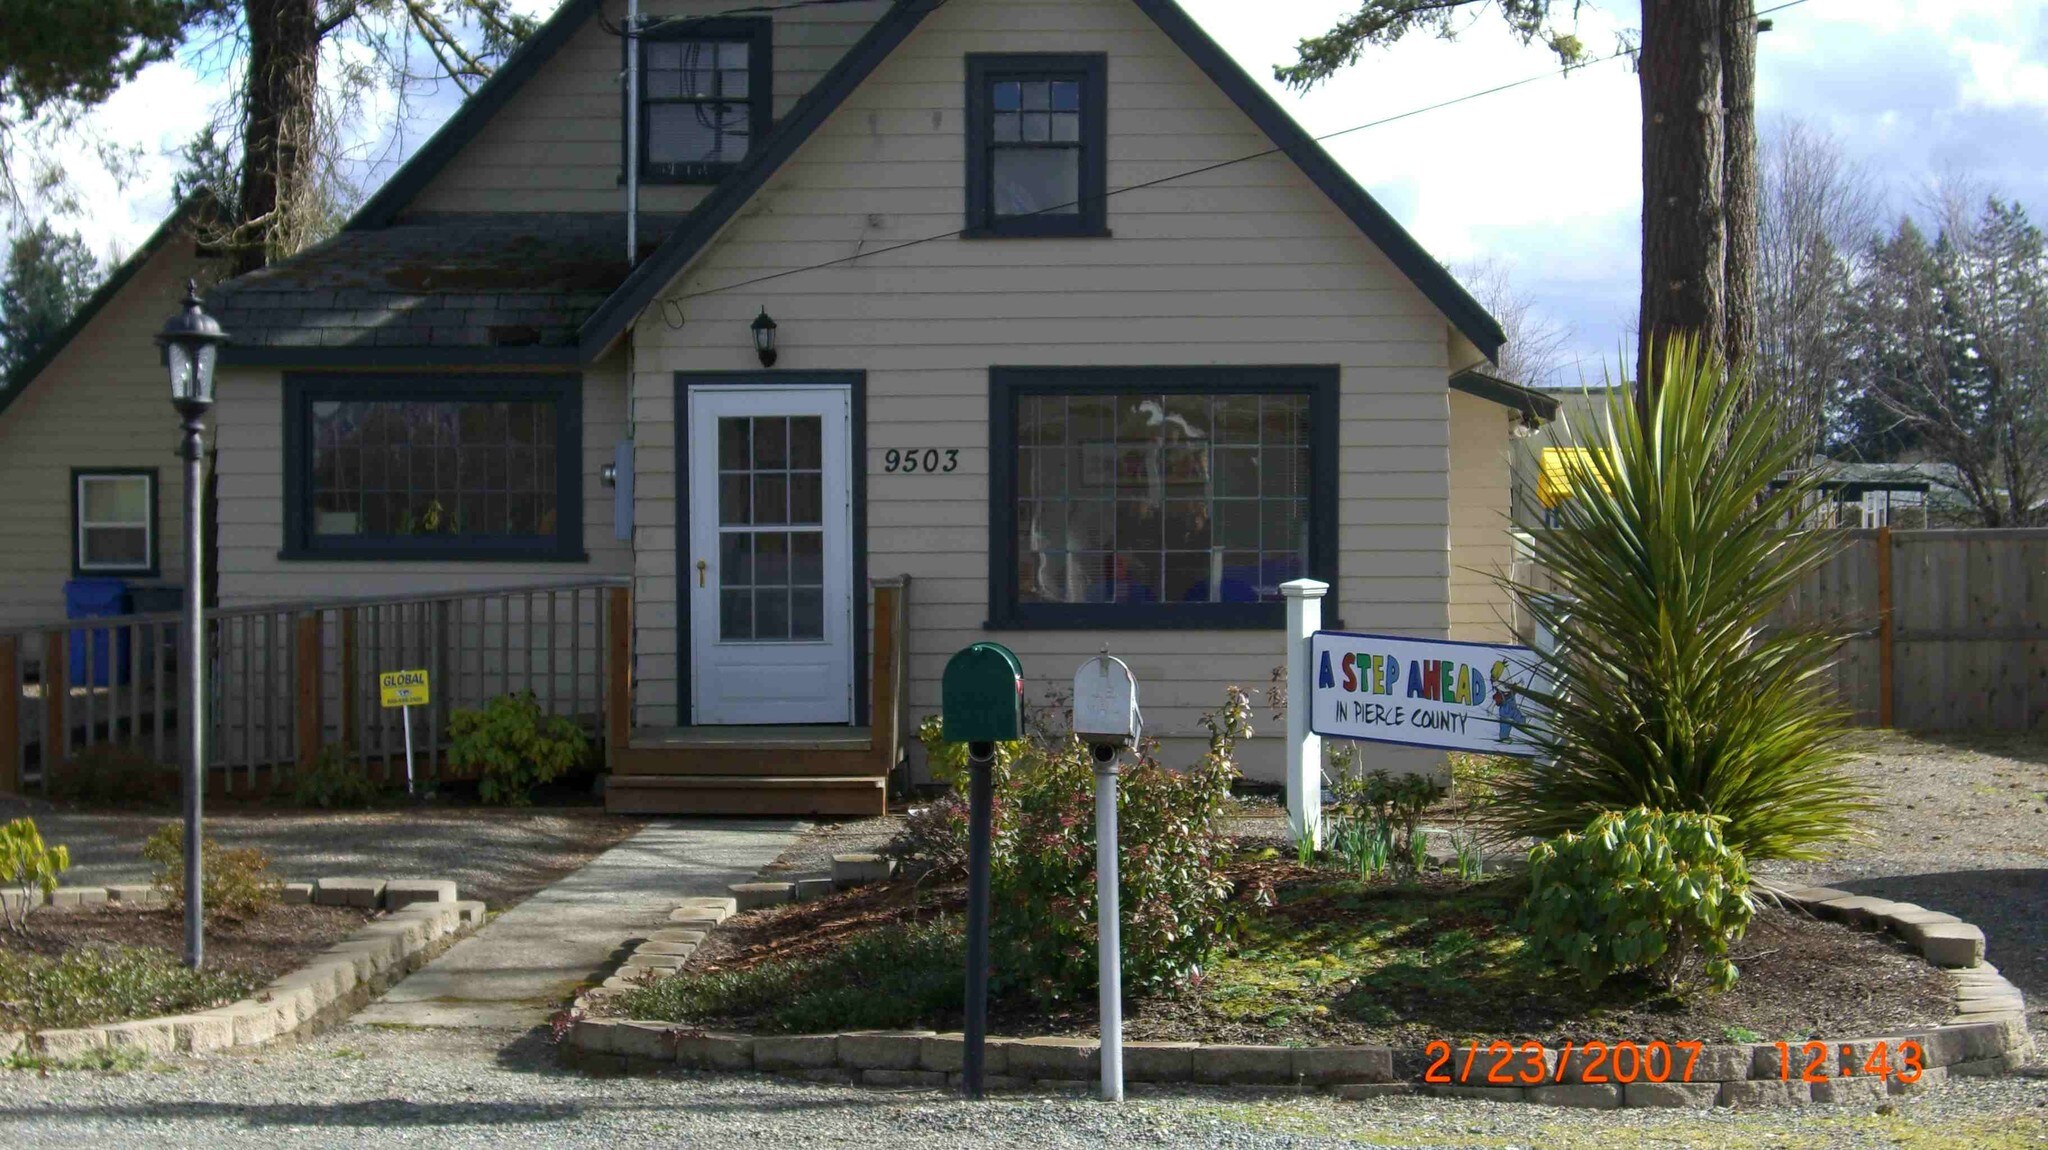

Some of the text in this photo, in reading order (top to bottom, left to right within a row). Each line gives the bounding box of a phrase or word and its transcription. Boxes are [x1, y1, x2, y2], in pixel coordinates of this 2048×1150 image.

[885, 449, 959, 472] 9503
[383, 673, 424, 687] GLOBAL
[1319, 650, 1486, 706] A STEP AHEAD
[1335, 700, 1468, 734] IN PIERCE COUNTY
